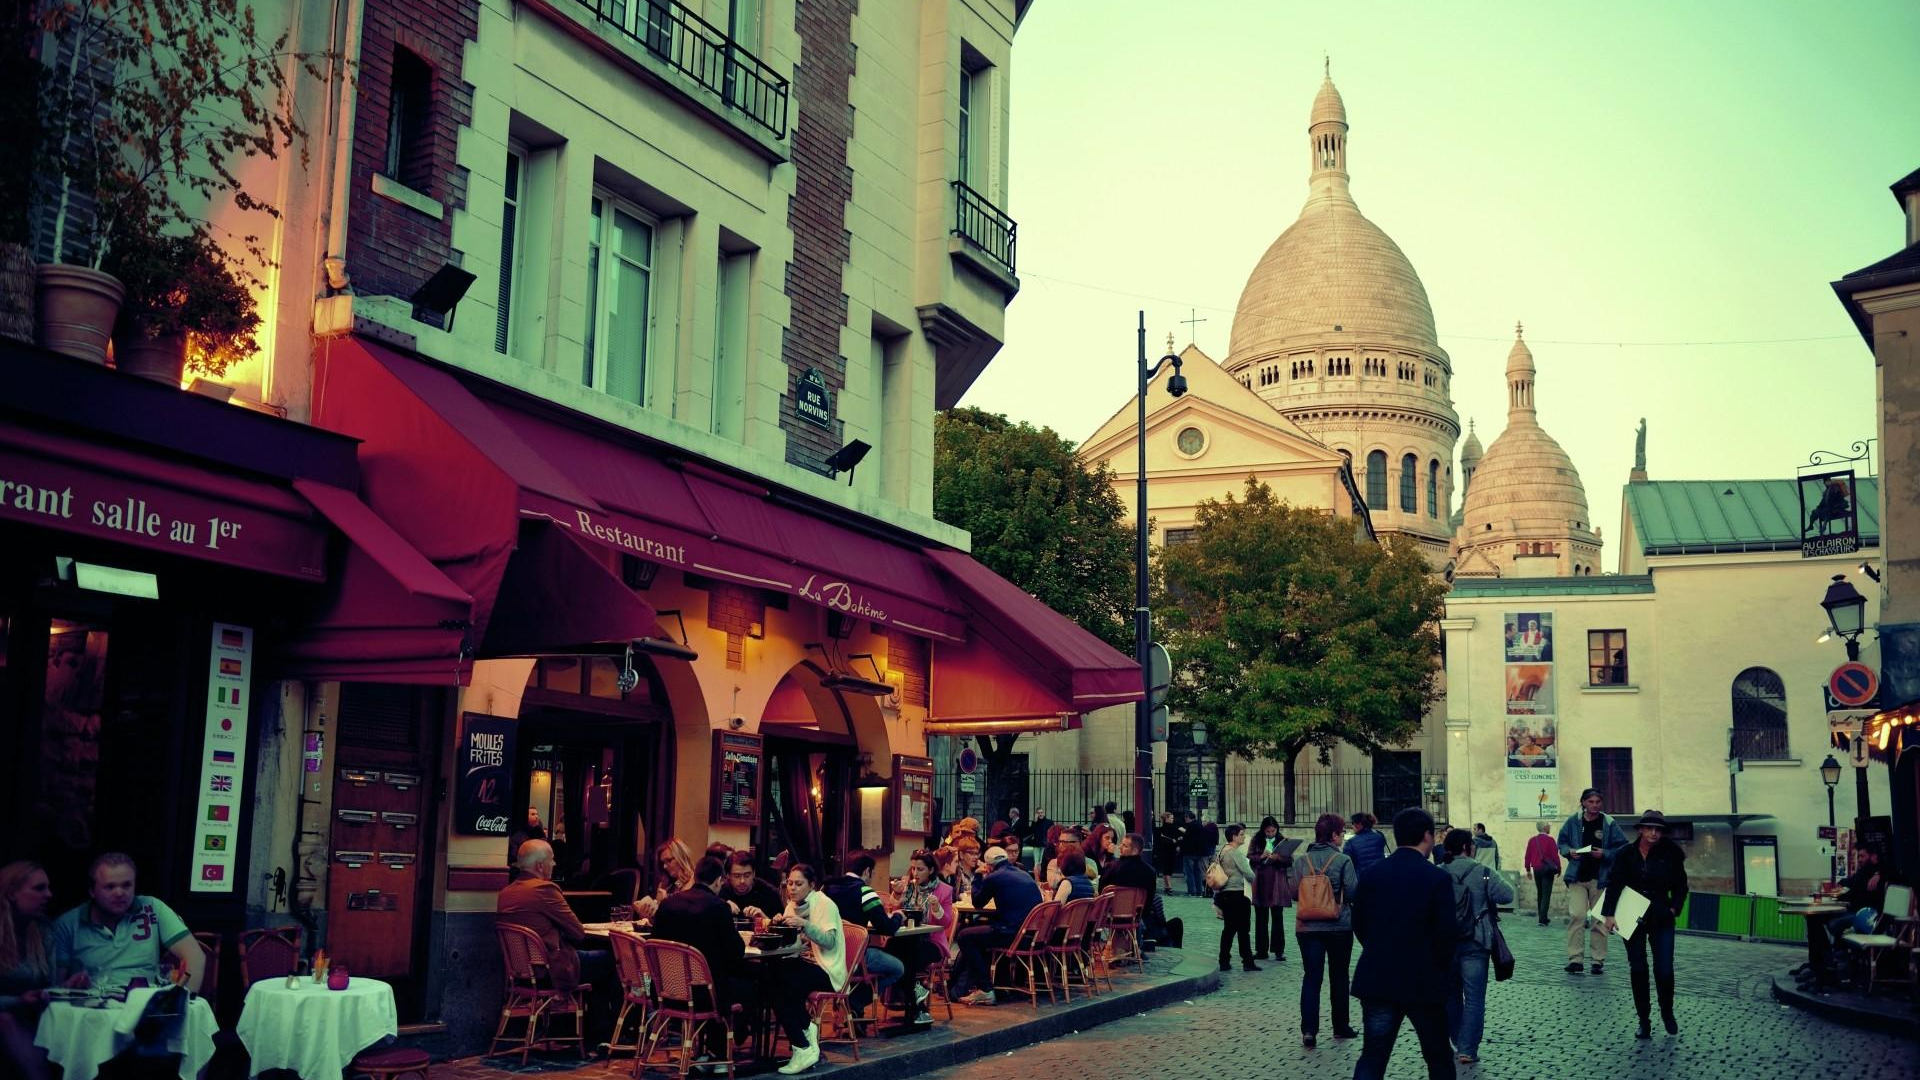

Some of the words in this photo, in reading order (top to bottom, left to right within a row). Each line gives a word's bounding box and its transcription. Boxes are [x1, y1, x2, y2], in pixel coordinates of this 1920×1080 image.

[807, 391, 821, 406] RUE
[799, 400, 828, 421] NORVINS
[0, 479, 74, 518] rant
[92, 497, 161, 537] salle
[169, 520, 196, 544] au
[205, 516, 242, 549] 1er
[1803, 542, 1815, 550] AU
[1816, 537, 1855, 548] CLAIRON
[575, 509, 686, 564] Restaurant
[798, 574, 822, 602] La
[822, 582, 888, 621] Bohème
[470, 732, 504, 751] MOULES
